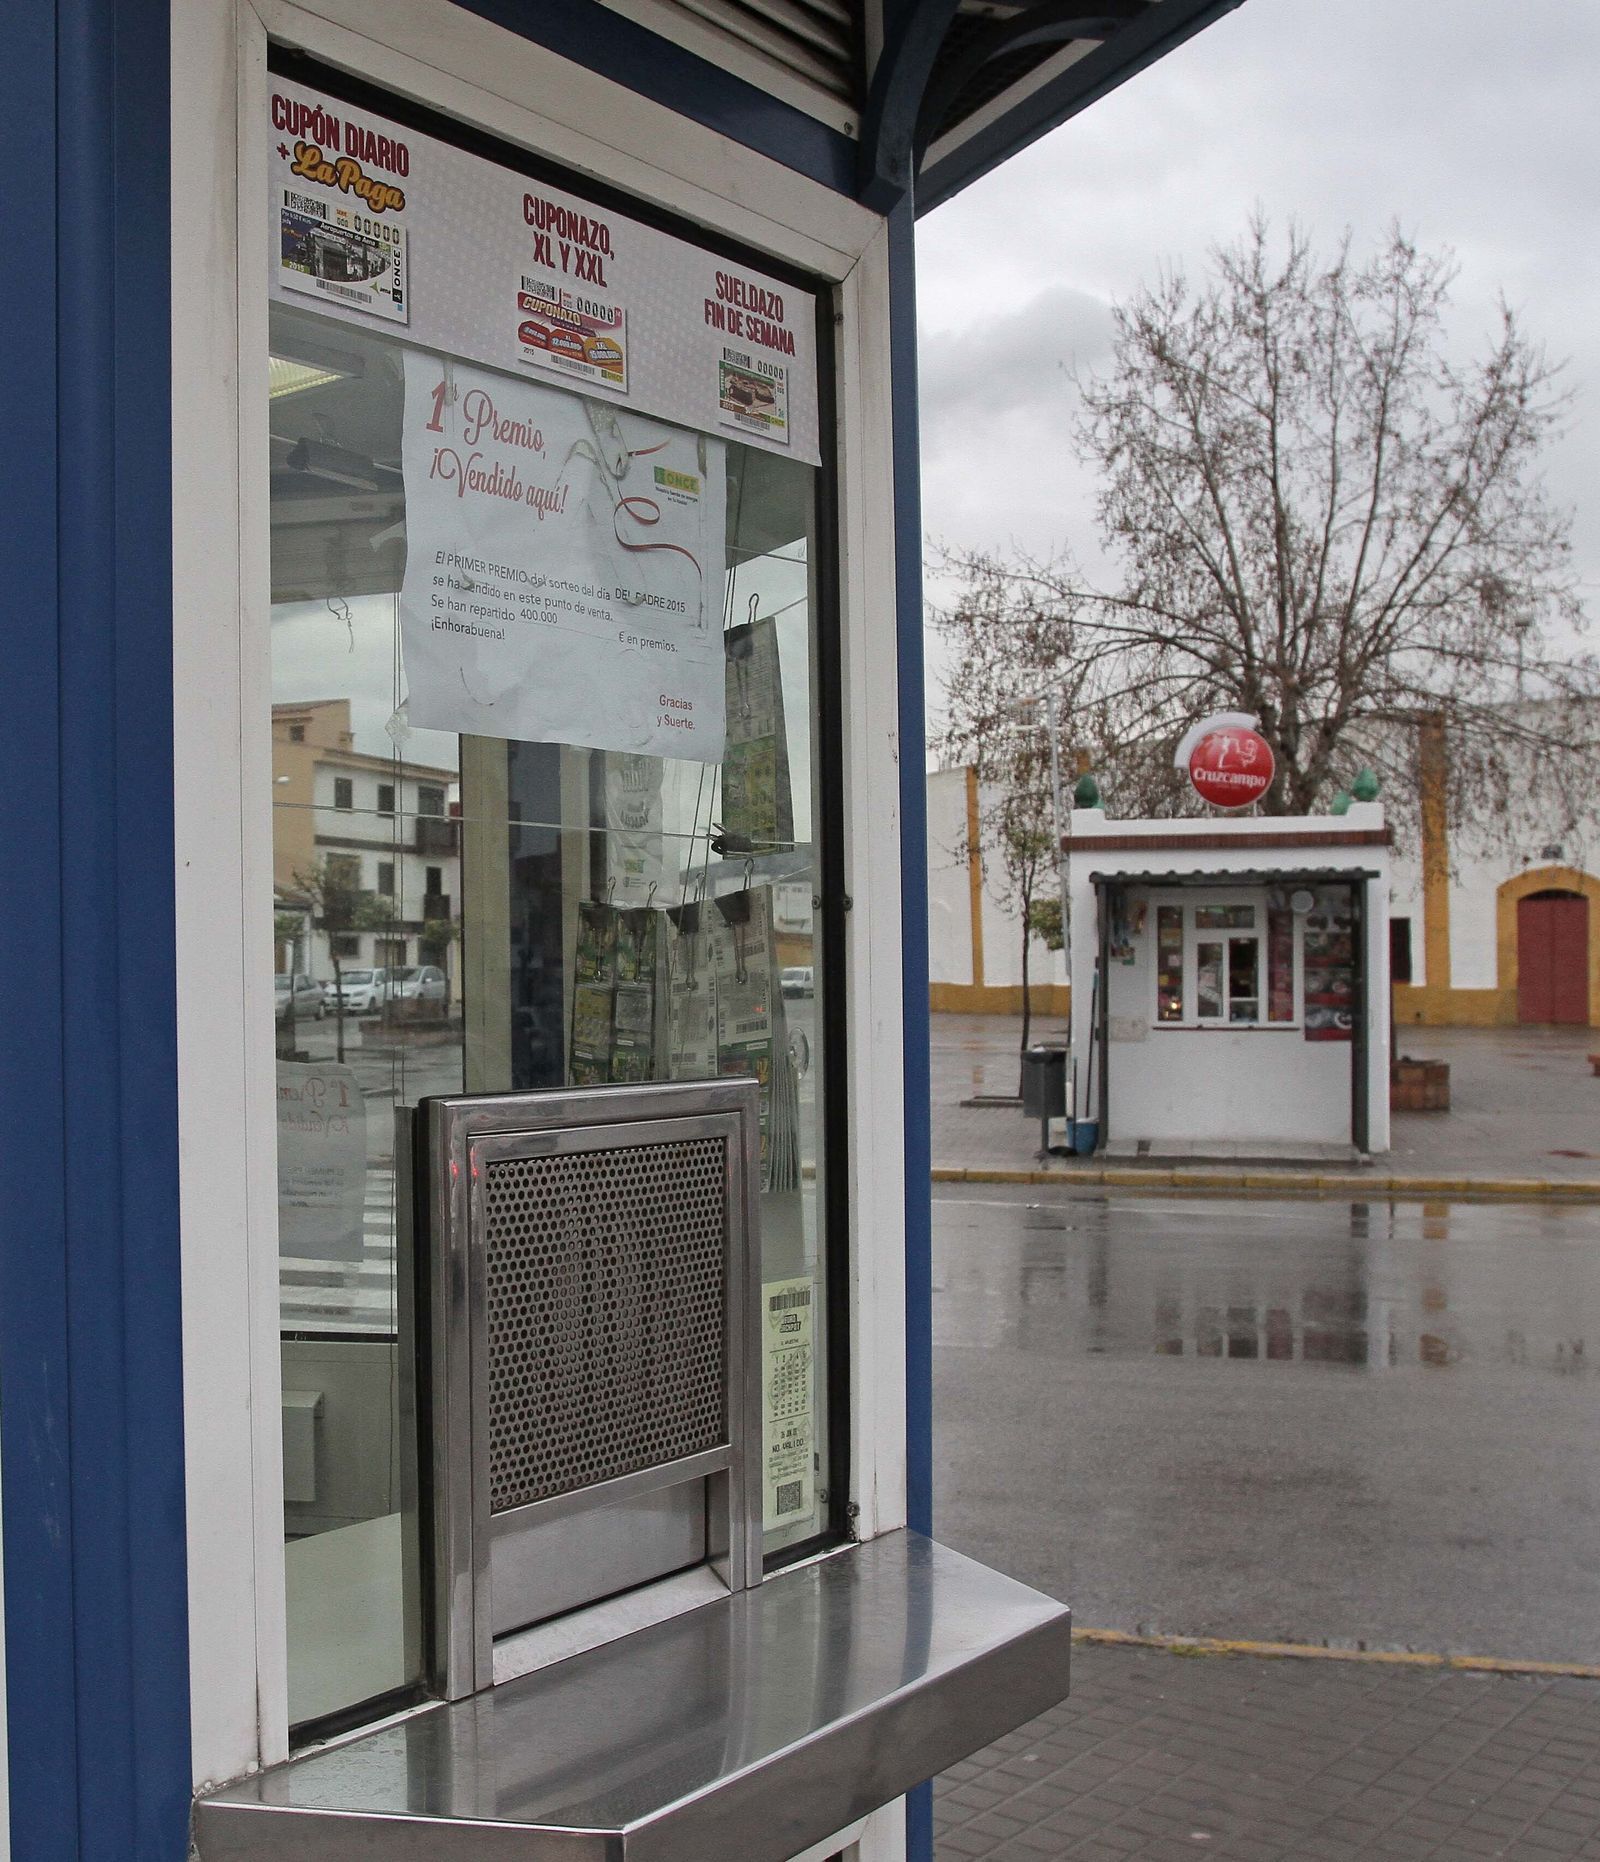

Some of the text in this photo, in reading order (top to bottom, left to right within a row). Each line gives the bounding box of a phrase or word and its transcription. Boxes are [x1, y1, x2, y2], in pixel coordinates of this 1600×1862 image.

[271, 94, 409, 177] CUPÓN DIARIO
[276, 141, 406, 213] + La Paga
[523, 193, 615, 260] CUPONAZO,
[289, 261, 305, 272] 2015
[393, 249, 402, 287] ONCE
[533, 231, 608, 288] XL Y XXL
[523, 296, 582, 326] CUPONAZO
[715, 271, 784, 323] SUELDAZO
[704, 299, 796, 357] FIN DE SEMANA
[463, 389, 546, 460] Premio,
[430, 448, 569, 521] ¡Vendido aquí!
[432, 574, 614, 621] se ha endido en este punto de venta.
[435, 551, 446, 564] El
[447, 553, 486, 574] PRIMER
[488, 563, 528, 583] PREMIO
[530, 573, 547, 587] del
[549, 579, 580, 593] sorteo
[581, 585, 594, 597] del
[666, 599, 686, 613] 2015
[431, 594, 679, 653] Se han repartido 400.000 € en premios.
[431, 616, 506, 640] ¡Enhorabuena!
[656, 714, 695, 730] y Suerte.
[659, 694, 693, 711] Gracias
[1193, 767, 1266, 788] Cruzcampo
